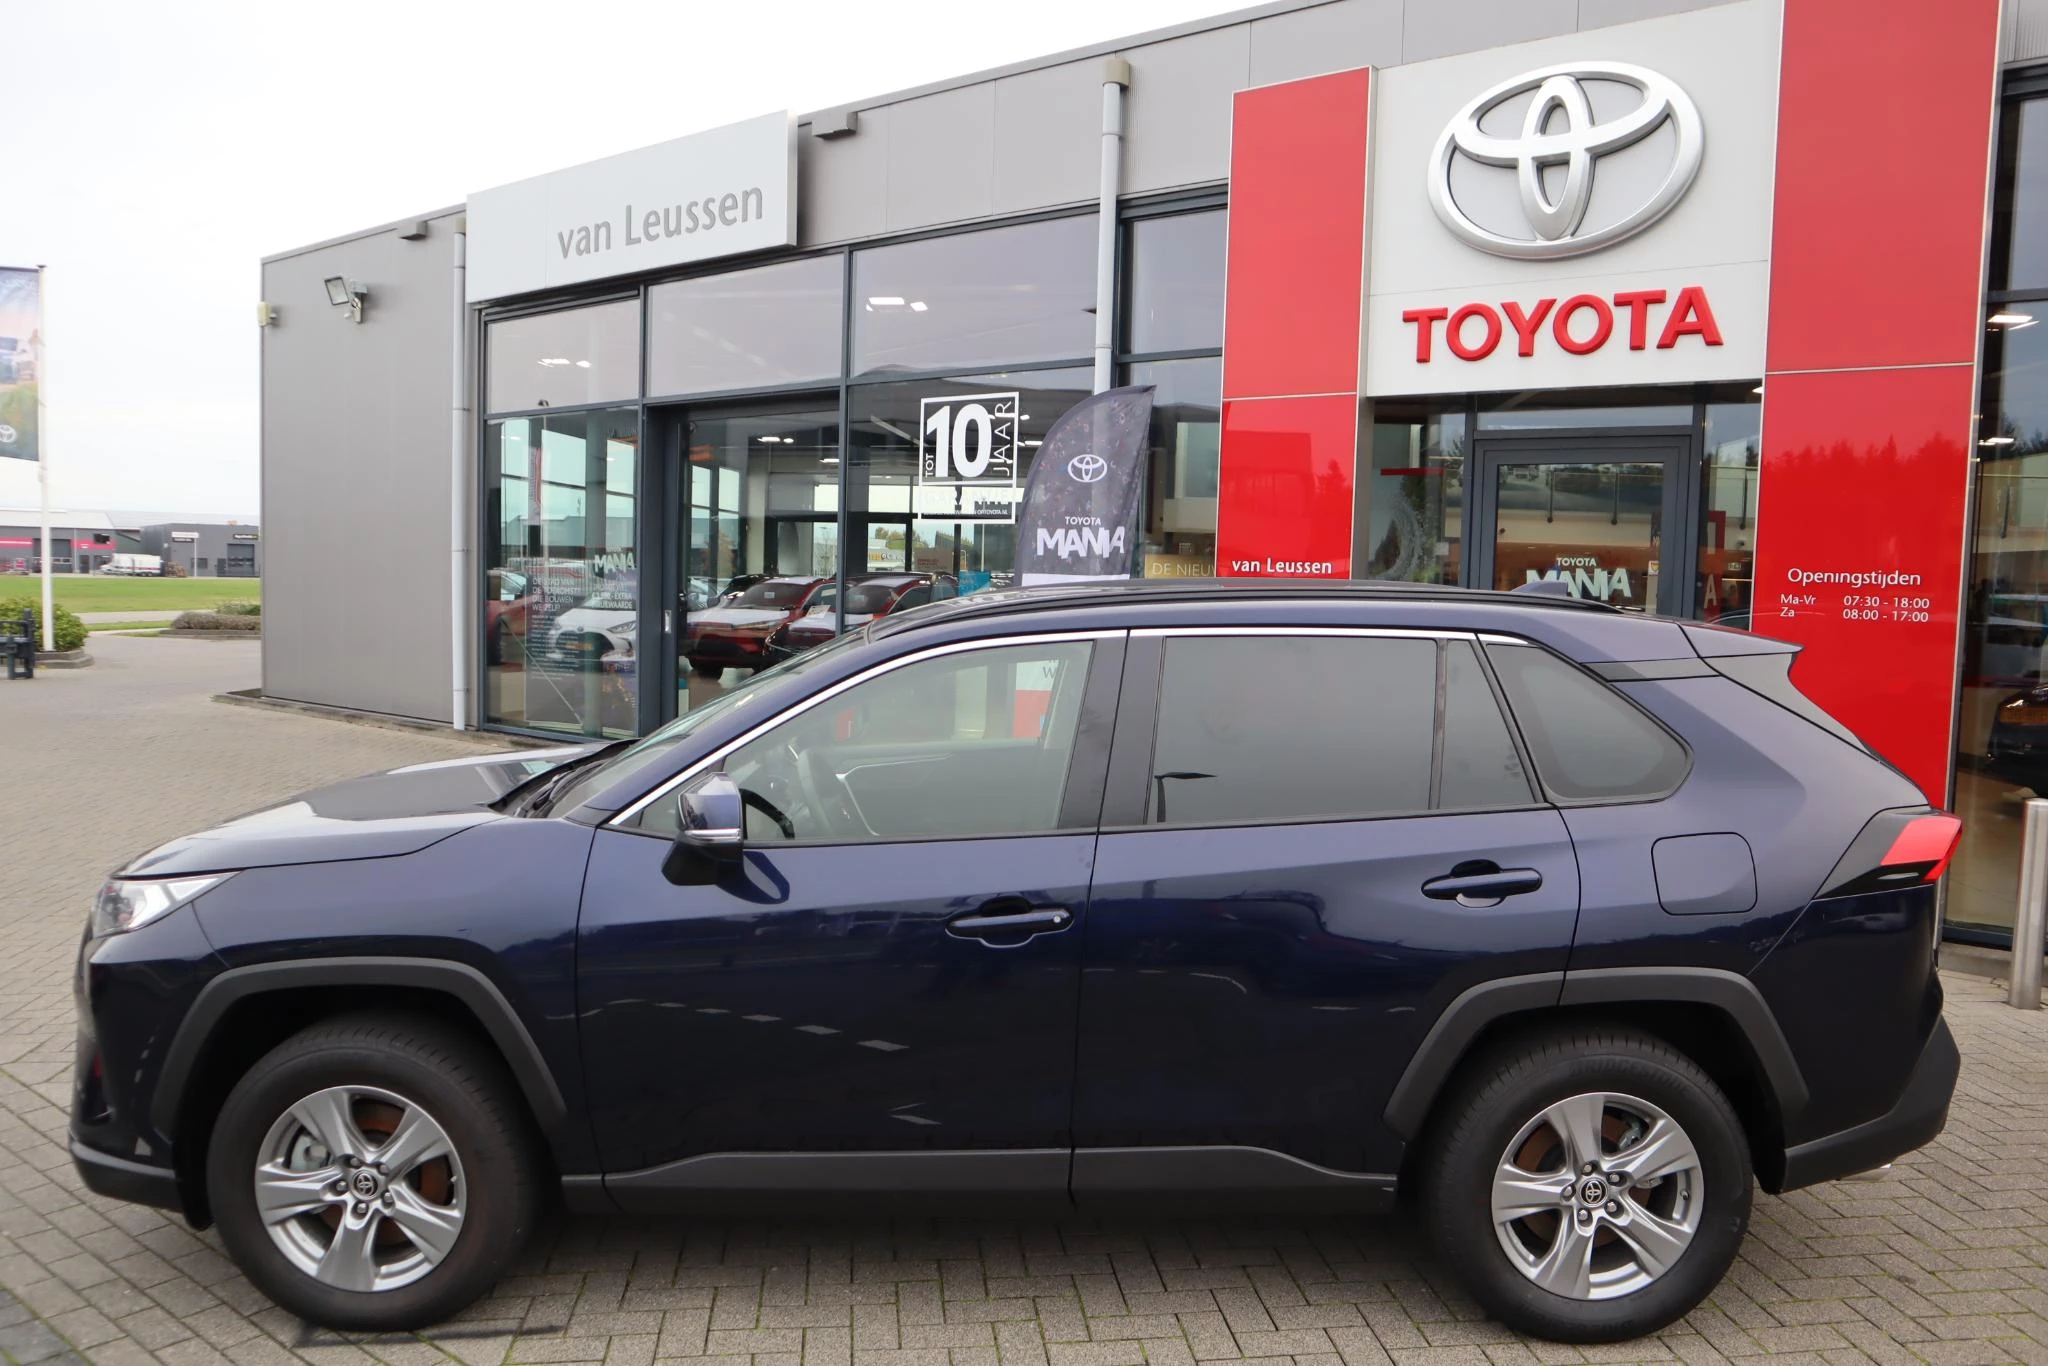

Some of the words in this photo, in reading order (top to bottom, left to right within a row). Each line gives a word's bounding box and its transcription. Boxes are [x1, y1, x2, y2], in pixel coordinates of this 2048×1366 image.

[557, 220, 611, 259] van
[625, 186, 763, 246] Leussen
[1402, 286, 1724, 363] TOYOTA
[926, 403, 992, 478] 10
[993, 401, 1012, 477] JAAR
[925, 453, 935, 478] TOT
[1065, 516, 1101, 526] TOYOTA
[1036, 526, 1125, 559] MANIA
[594, 551, 636, 573] MANIA
[1152, 562, 1171, 575] DE
[1231, 560, 1260, 573] van
[1266, 558, 1332, 574] Leussen
[1556, 557, 1597, 567] TOYOTA
[1787, 568, 1921, 589] Openingstijden
[1780, 594, 1816, 605] Ma-Vr
[1843, 596, 1880, 607] 07:30
[1895, 597, 1930, 609] 18:00
[1780, 607, 1795, 617] Za
[1843, 609, 1879, 620] 08:00
[1892, 611, 1929, 622] 17:00
